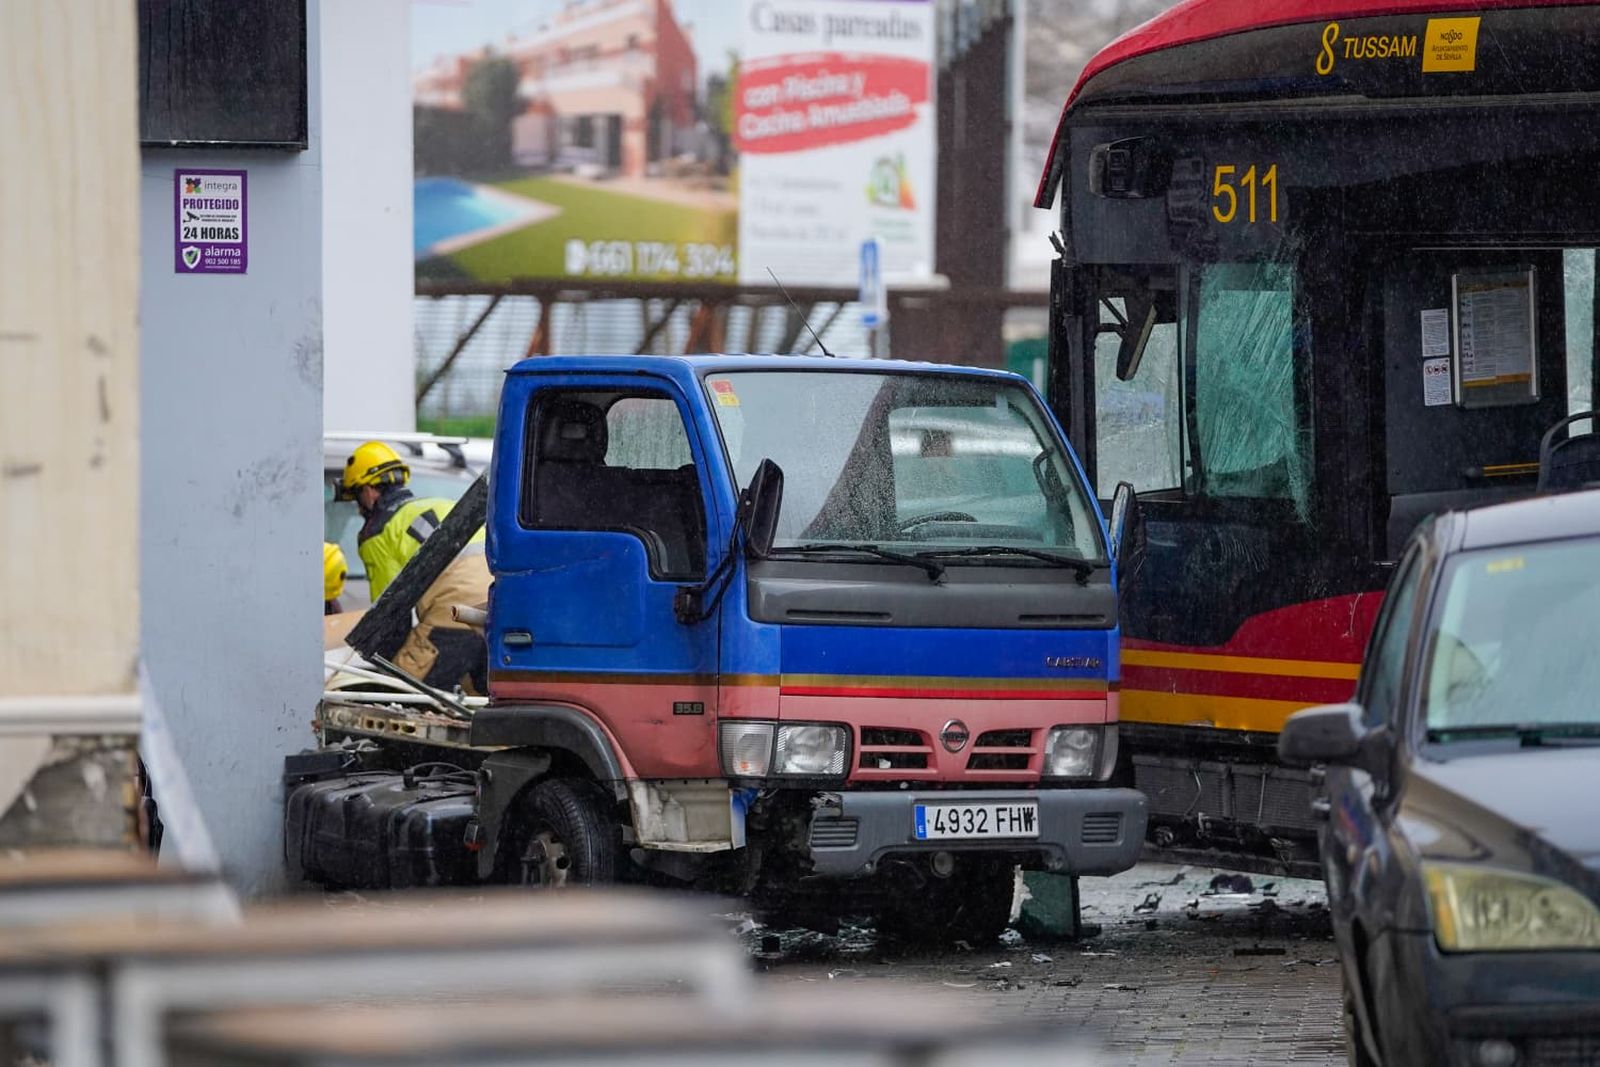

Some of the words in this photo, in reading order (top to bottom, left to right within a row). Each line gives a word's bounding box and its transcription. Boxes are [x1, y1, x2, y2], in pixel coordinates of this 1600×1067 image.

[752, 2, 817, 33] Casas
[822, 9, 922, 45] pareadas
[1343, 35, 1417, 58] TUSSAM
[204, 181, 238, 192] integra
[1212, 163, 1278, 224] 511
[183, 198, 240, 210] PROTEGIDO
[183, 227, 198, 240] 24
[200, 227, 240, 240] HORAS
[204, 245, 241, 257] alarma
[934, 808, 989, 835] 4932
[995, 806, 1035, 833] FHW
